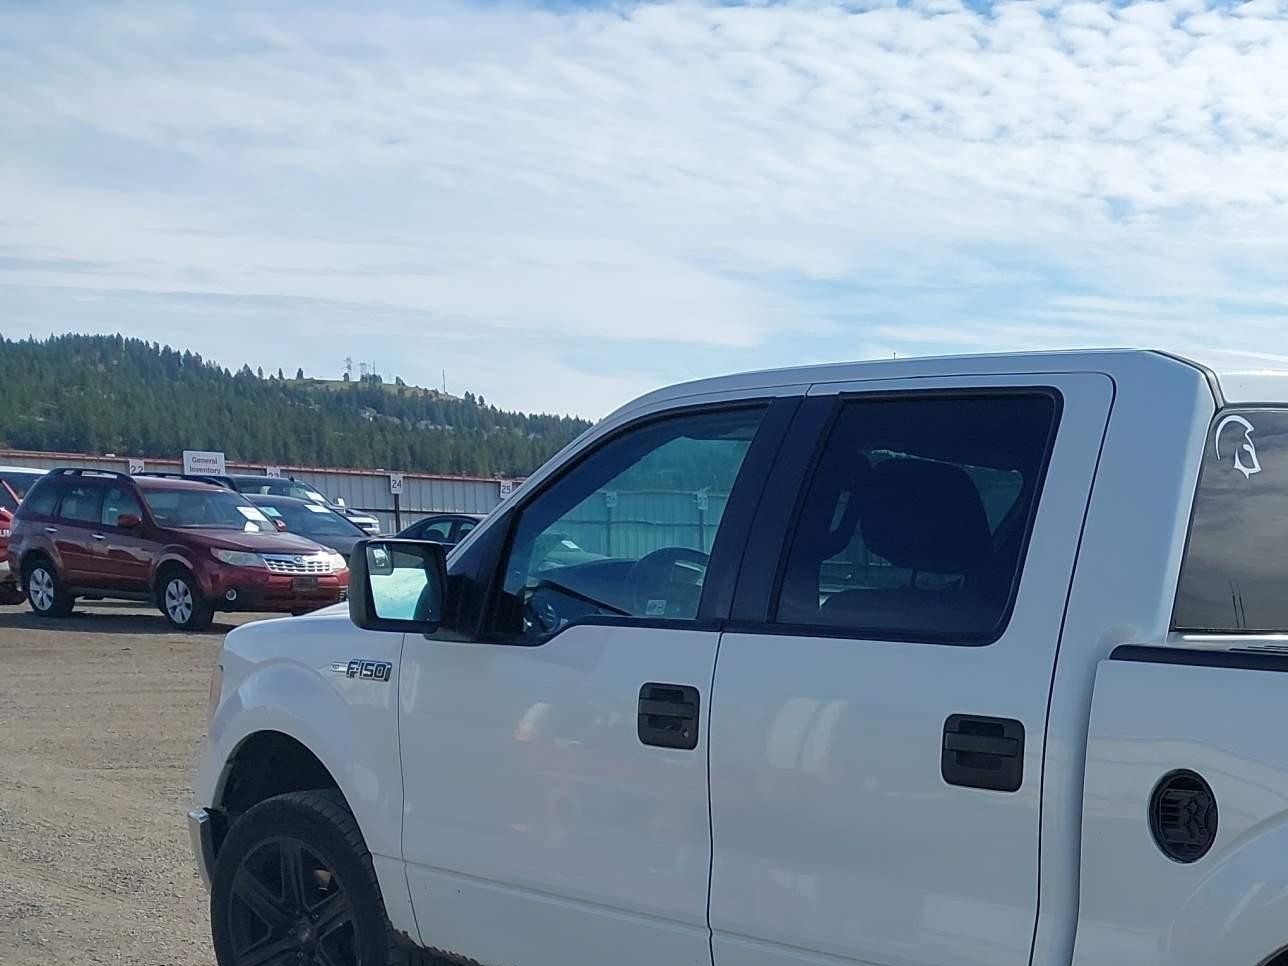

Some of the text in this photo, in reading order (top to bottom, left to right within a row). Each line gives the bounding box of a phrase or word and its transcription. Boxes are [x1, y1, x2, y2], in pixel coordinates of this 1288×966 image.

[191, 456, 218, 465] General
[130, 464, 144, 474] 22
[189, 465, 221, 474] Inventory
[391, 479, 401, 489] 24
[501, 484, 512, 494] 25
